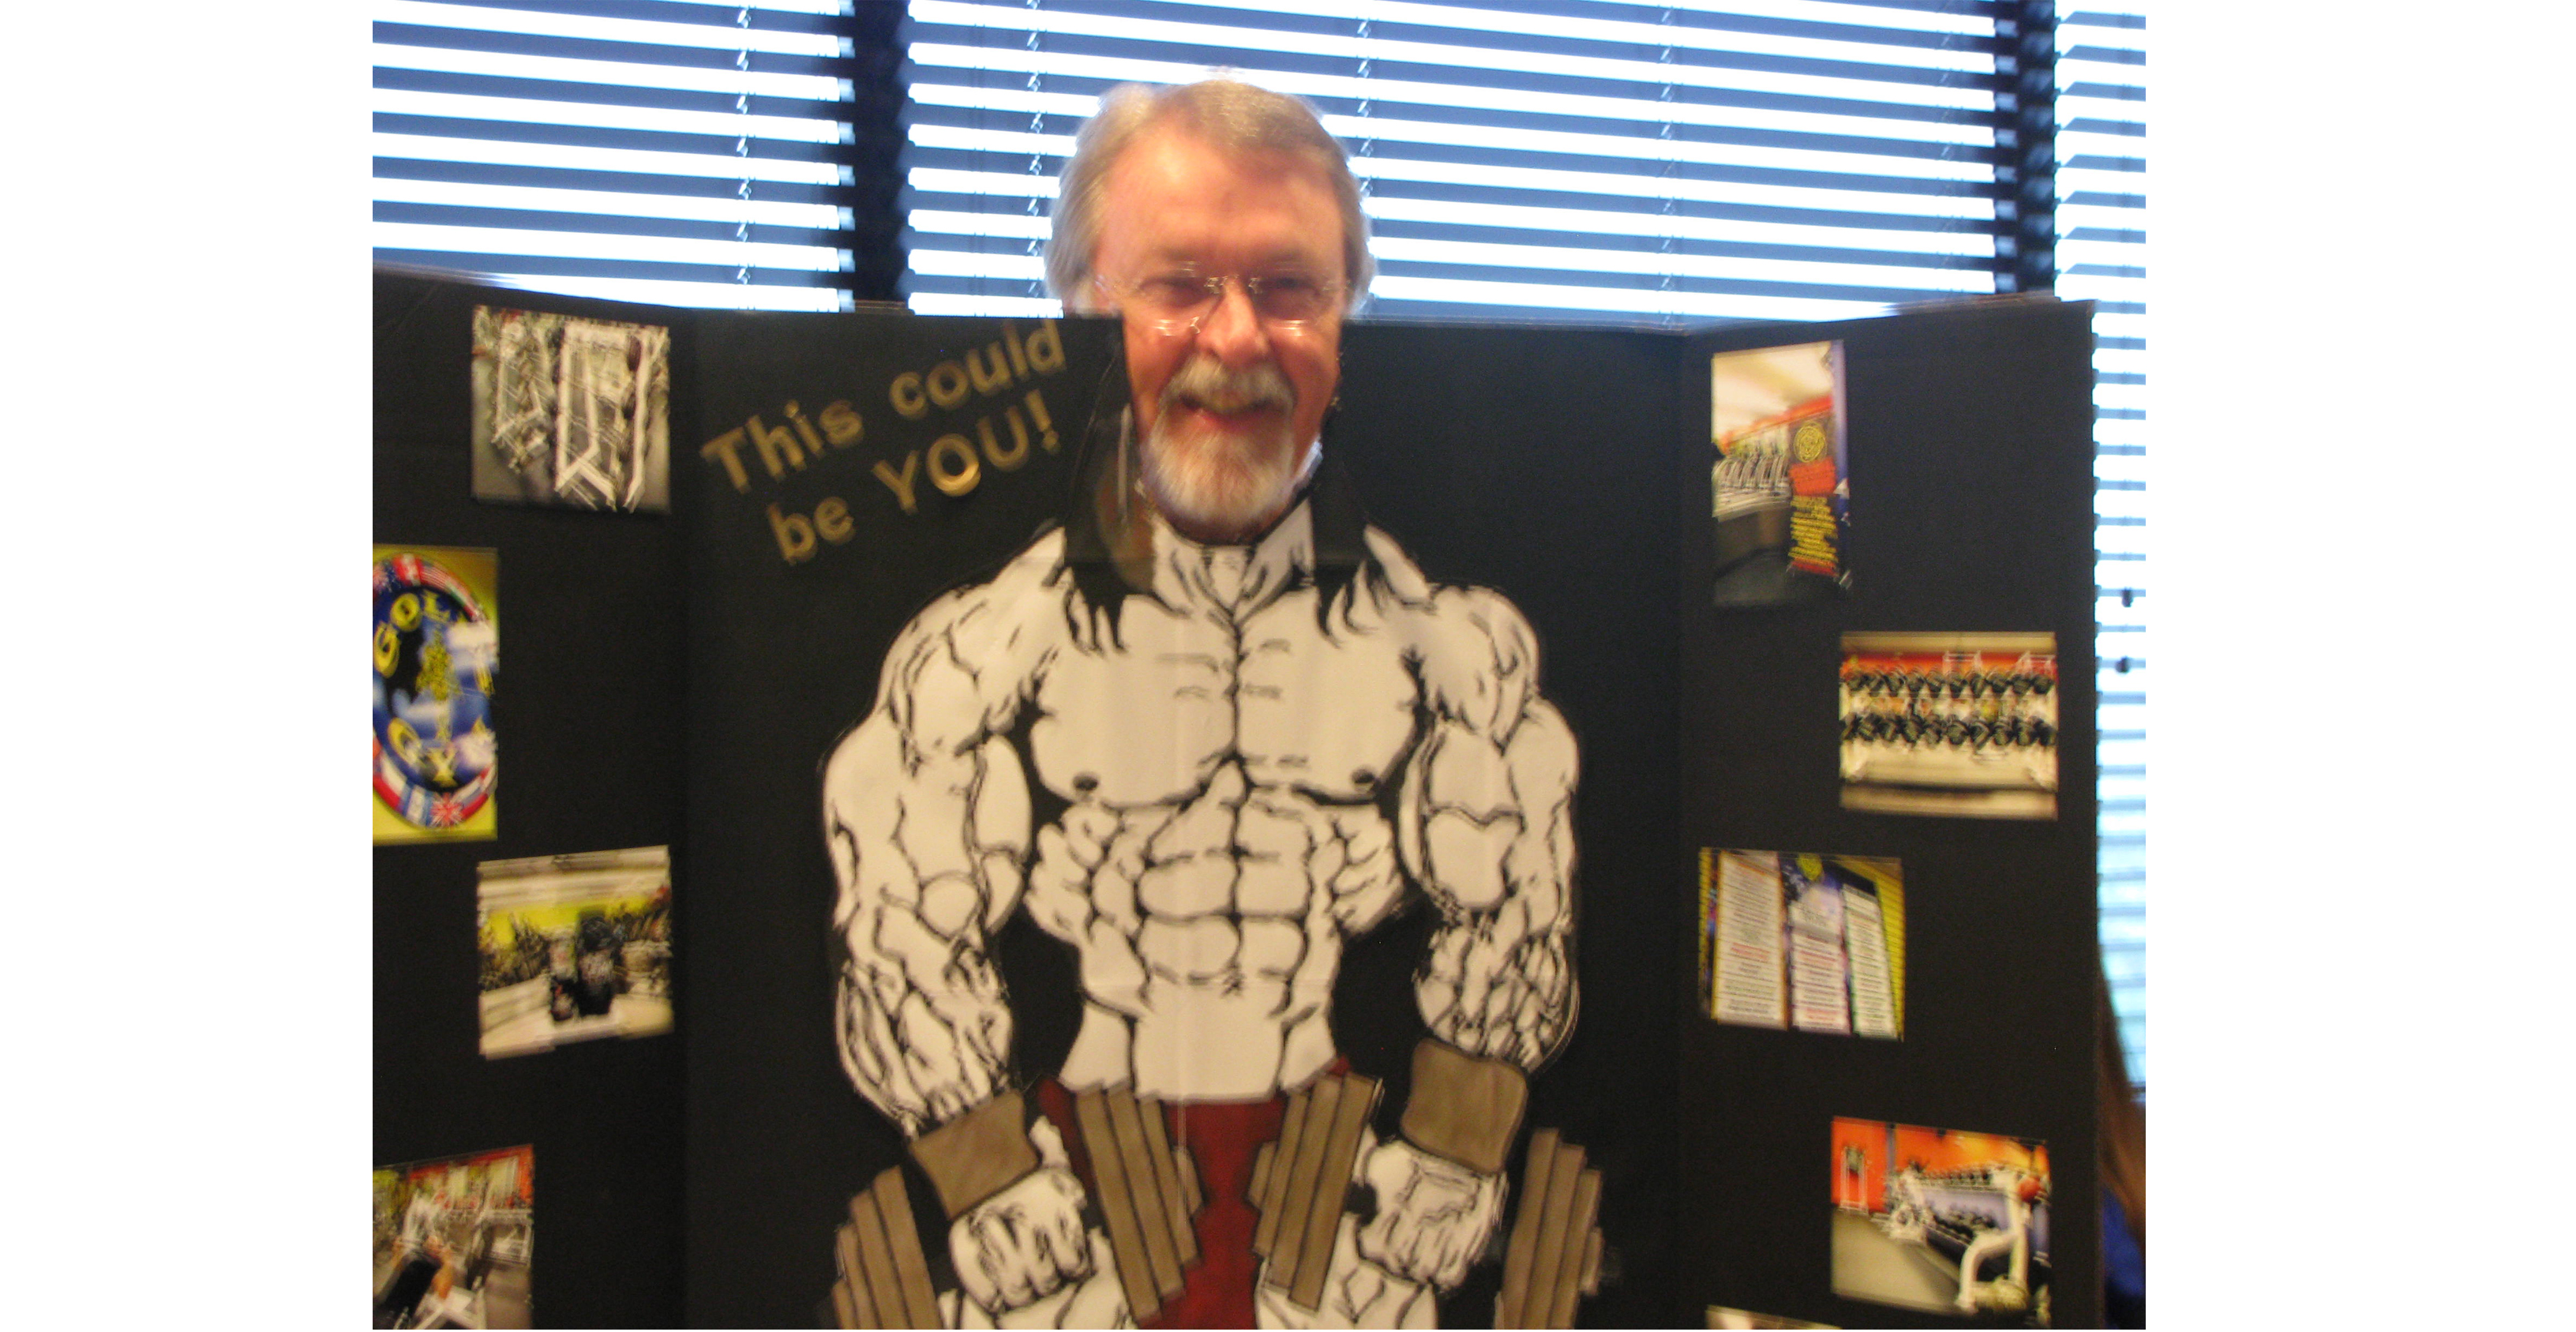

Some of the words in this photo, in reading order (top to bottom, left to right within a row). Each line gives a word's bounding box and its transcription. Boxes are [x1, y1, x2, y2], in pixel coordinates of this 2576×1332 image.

[700, 399, 864, 495] This
[889, 318, 1067, 420] could
[766, 496, 856, 566] be
[872, 388, 1061, 516] YOU!
